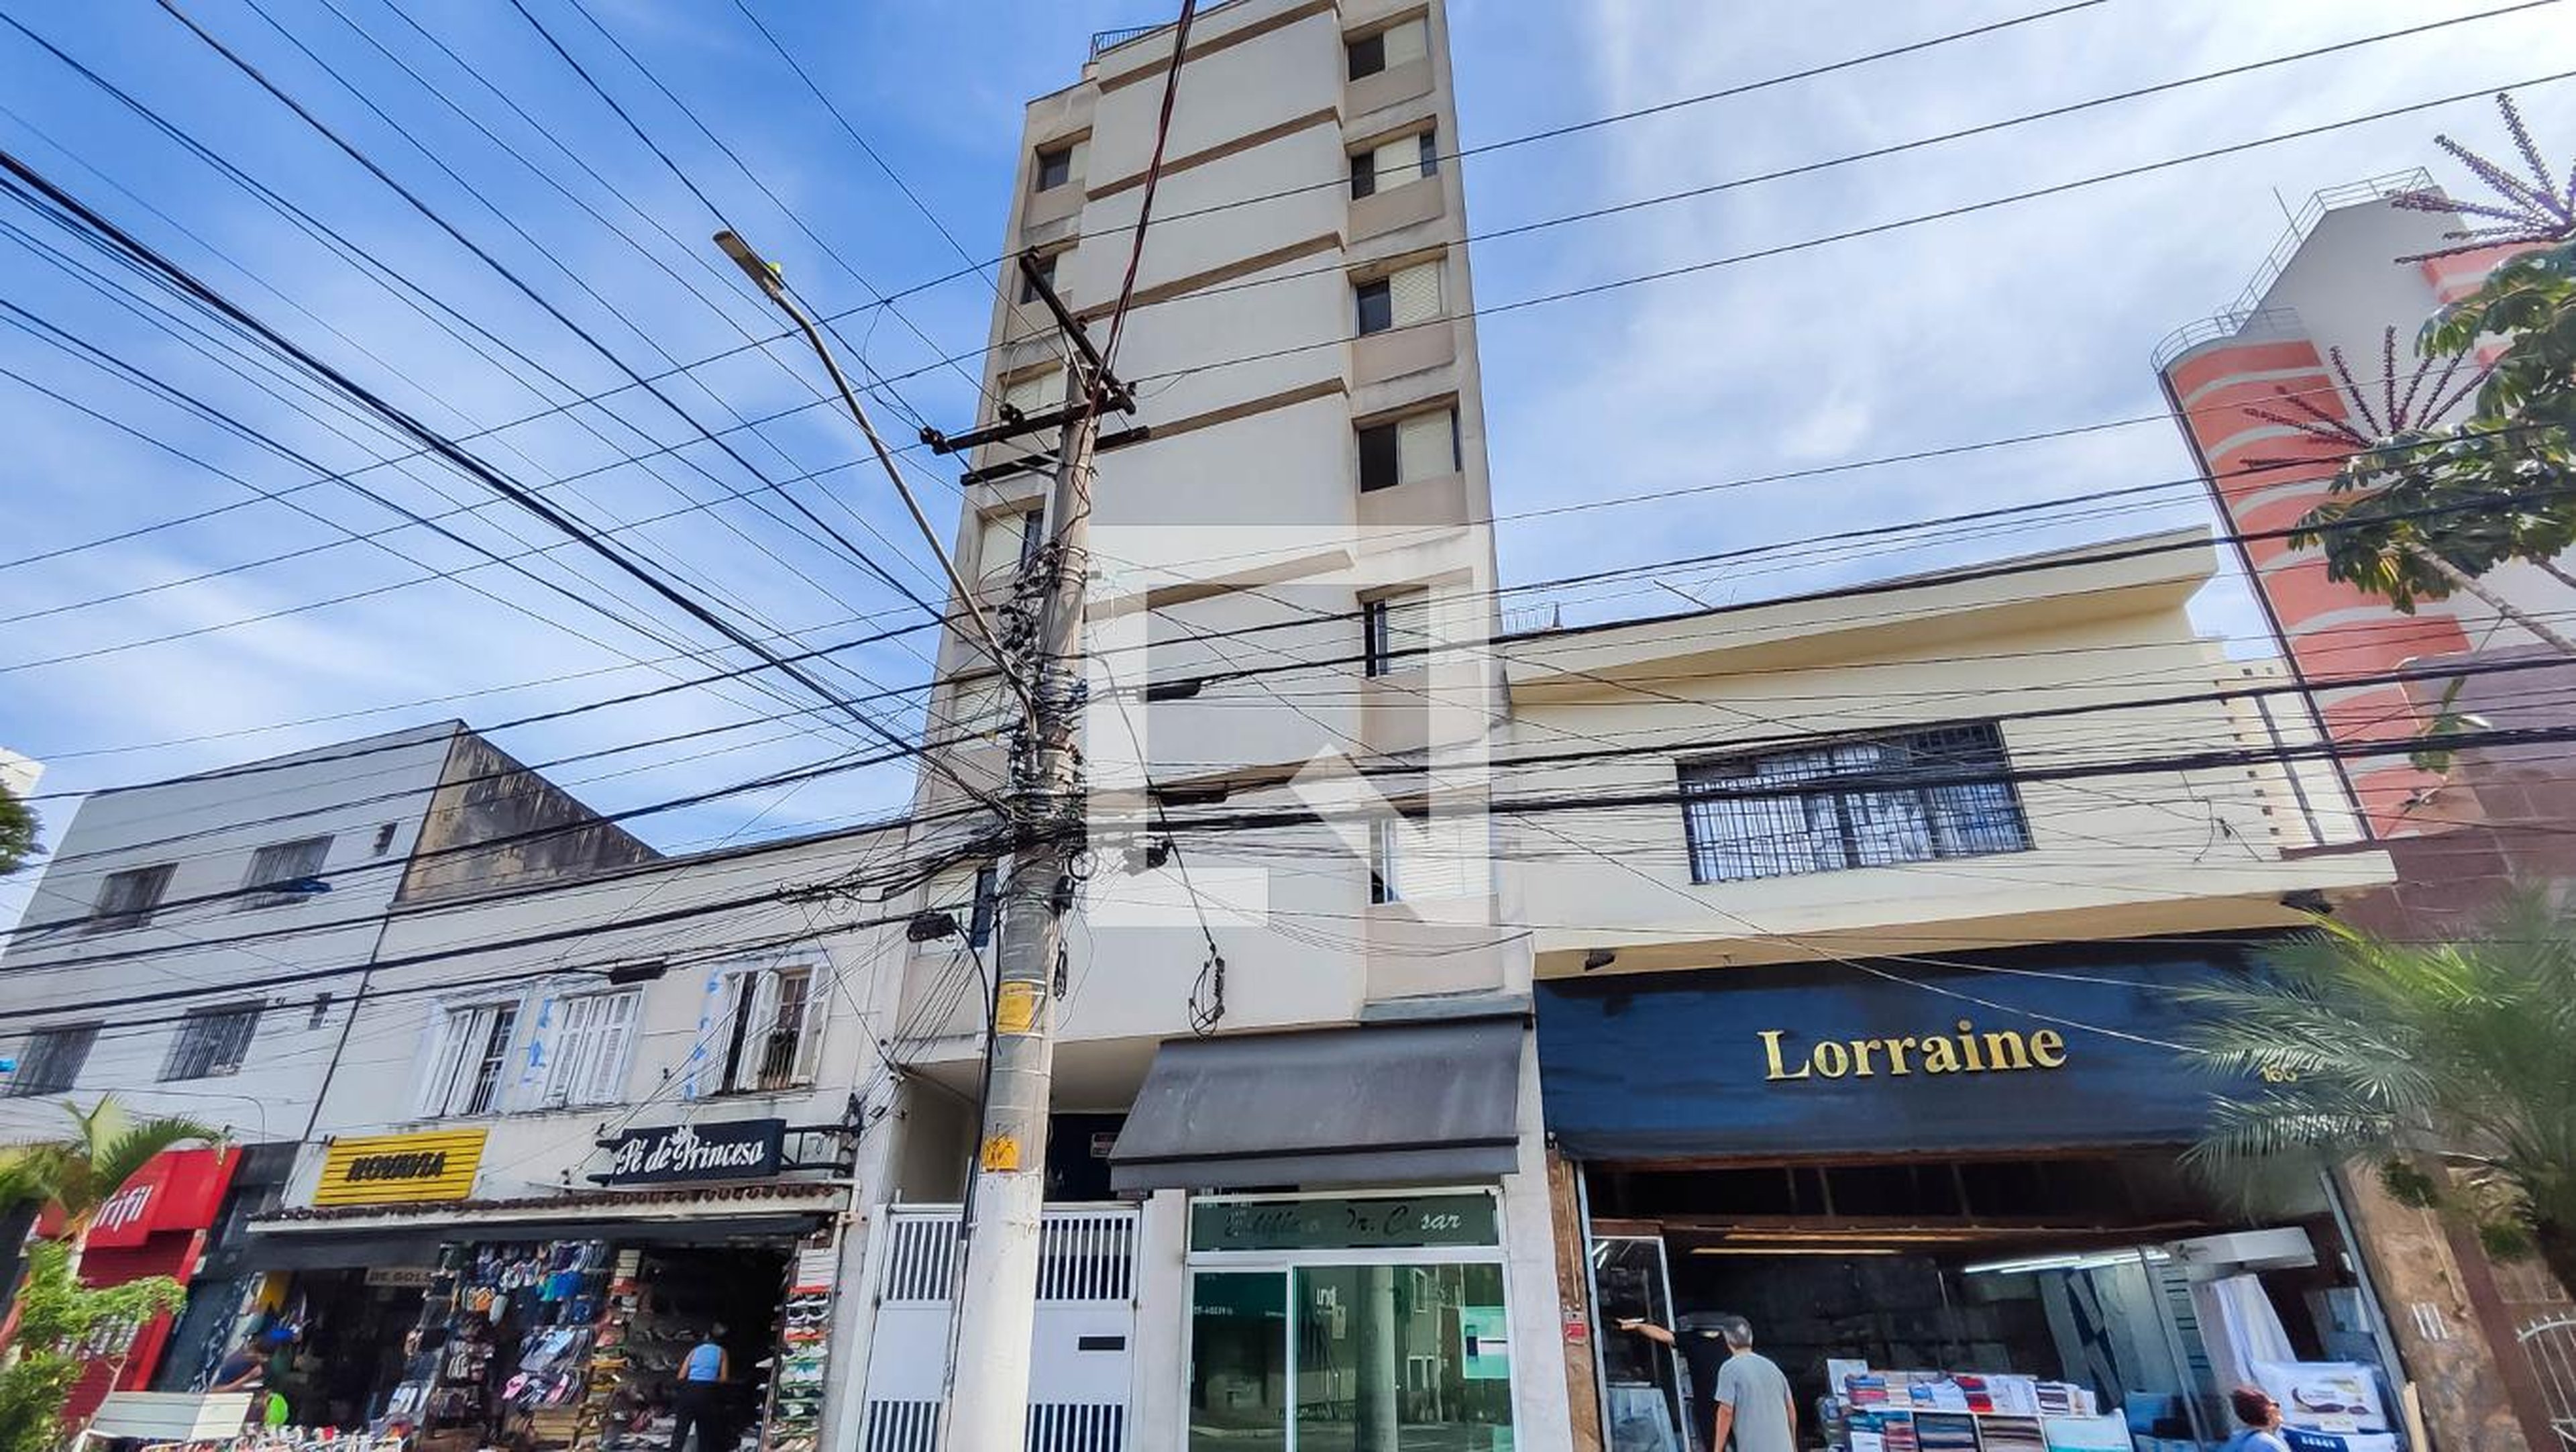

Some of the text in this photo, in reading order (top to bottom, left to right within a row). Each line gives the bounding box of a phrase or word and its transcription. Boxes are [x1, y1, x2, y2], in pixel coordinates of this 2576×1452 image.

[1756, 1019, 2068, 1080] Lorraine
[644, 1137, 672, 1172] de
[672, 1135, 765, 1172] Princesa
